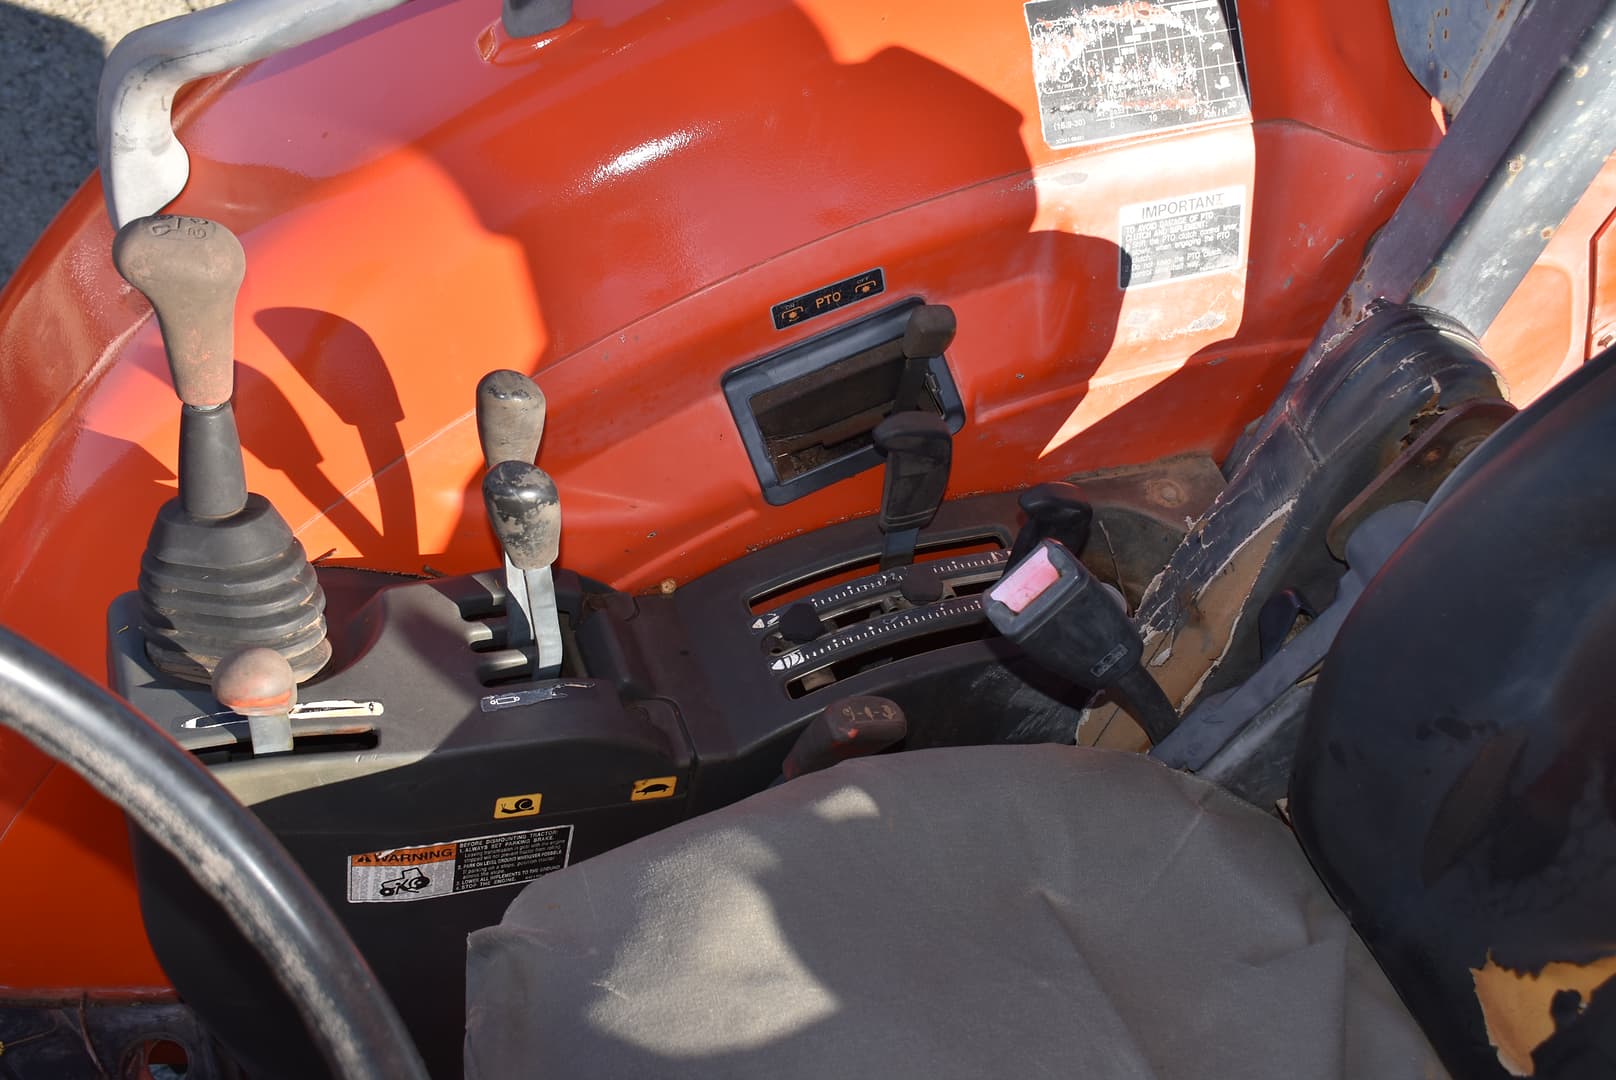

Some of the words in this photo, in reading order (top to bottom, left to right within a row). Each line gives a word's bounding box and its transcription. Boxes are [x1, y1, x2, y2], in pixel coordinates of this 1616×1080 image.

[1142, 193, 1225, 220] IMPORTANT
[1137, 221, 1157, 233] AVOID
[1200, 211, 1214, 221] PTO
[1126, 230, 1152, 241] CLUTCH
[1153, 227, 1169, 238] AND
[1162, 232, 1176, 243] PTO
[1217, 230, 1230, 241] PTO
[1187, 251, 1200, 261] PTO
[815, 291, 841, 309] PTO
[460, 840, 483, 848] BEFORE
[504, 838, 530, 847] PARKING
[374, 848, 453, 863] WARNING
